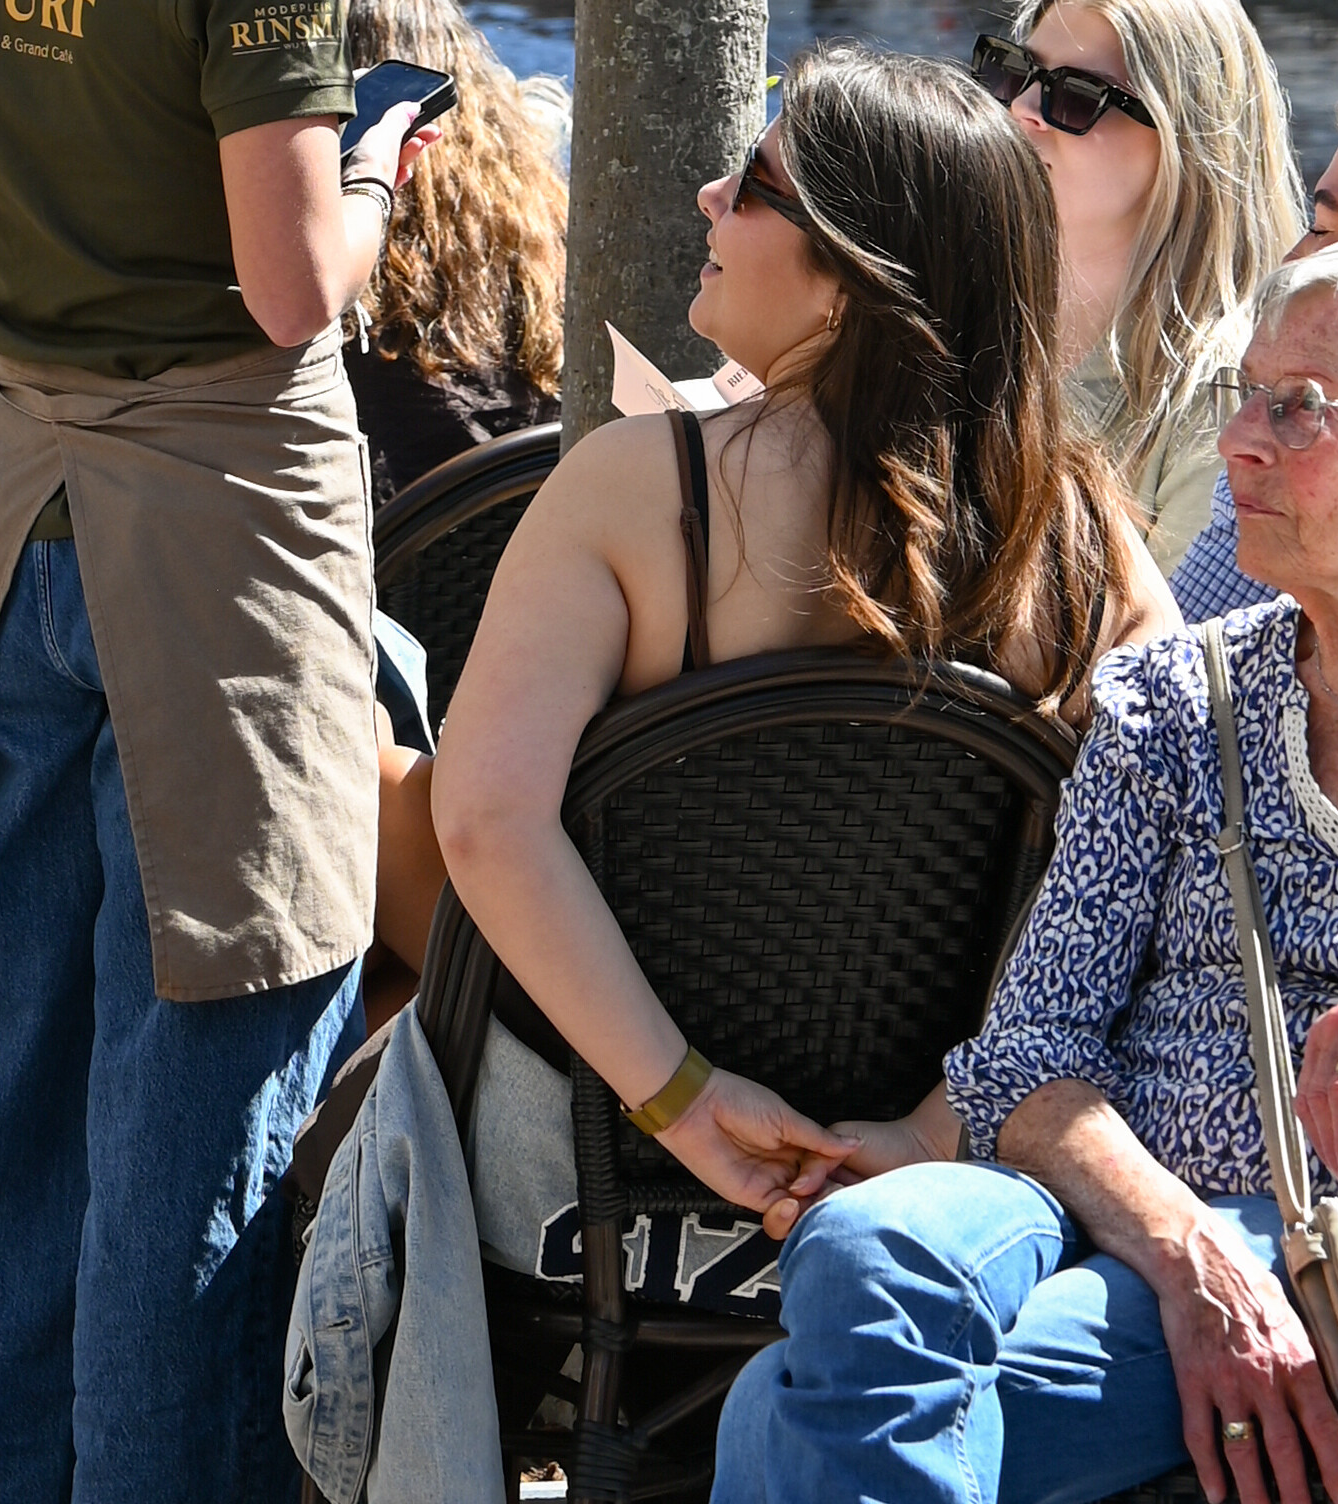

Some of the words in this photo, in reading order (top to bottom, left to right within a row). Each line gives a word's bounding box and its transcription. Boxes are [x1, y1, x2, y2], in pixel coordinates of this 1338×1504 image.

[229, 13, 341, 49] RINSM
[0, 34, 12, 51] &
[14, 38, 49, 59] Grand
